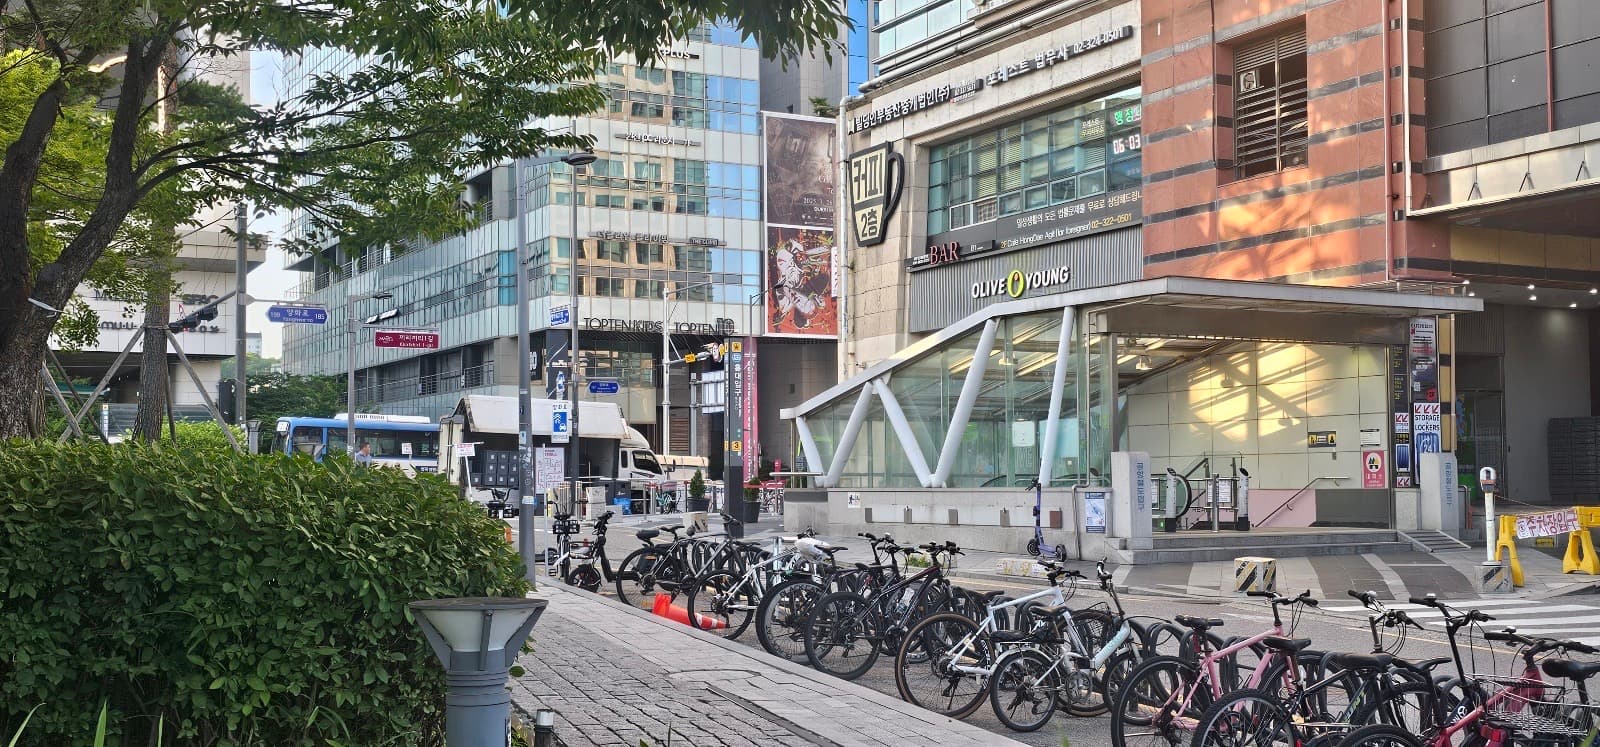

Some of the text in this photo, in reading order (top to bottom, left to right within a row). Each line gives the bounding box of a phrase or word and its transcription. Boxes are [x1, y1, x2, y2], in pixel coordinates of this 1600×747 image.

[986, 27, 1123, 86] 포레스트 법무사 02-324-0501
[853, 152, 883, 201] 커피
[860, 208, 878, 238] 2층
[1016, 213, 1043, 229] 일상생활의
[1045, 210, 1056, 221] 모든
[1057, 203, 1086, 219] 법률문제를
[1087, 199, 1105, 212] 무료로
[930, 241, 960, 265] BAR
[971, 278, 1006, 299] OLIVE
[1025, 265, 1070, 290] YOUNG
[286, 309, 309, 317] 양화로
[584, 317, 631, 331] TOPTEN
[634, 319, 664, 333] KIDS
[734, 441, 739, 449] 3
